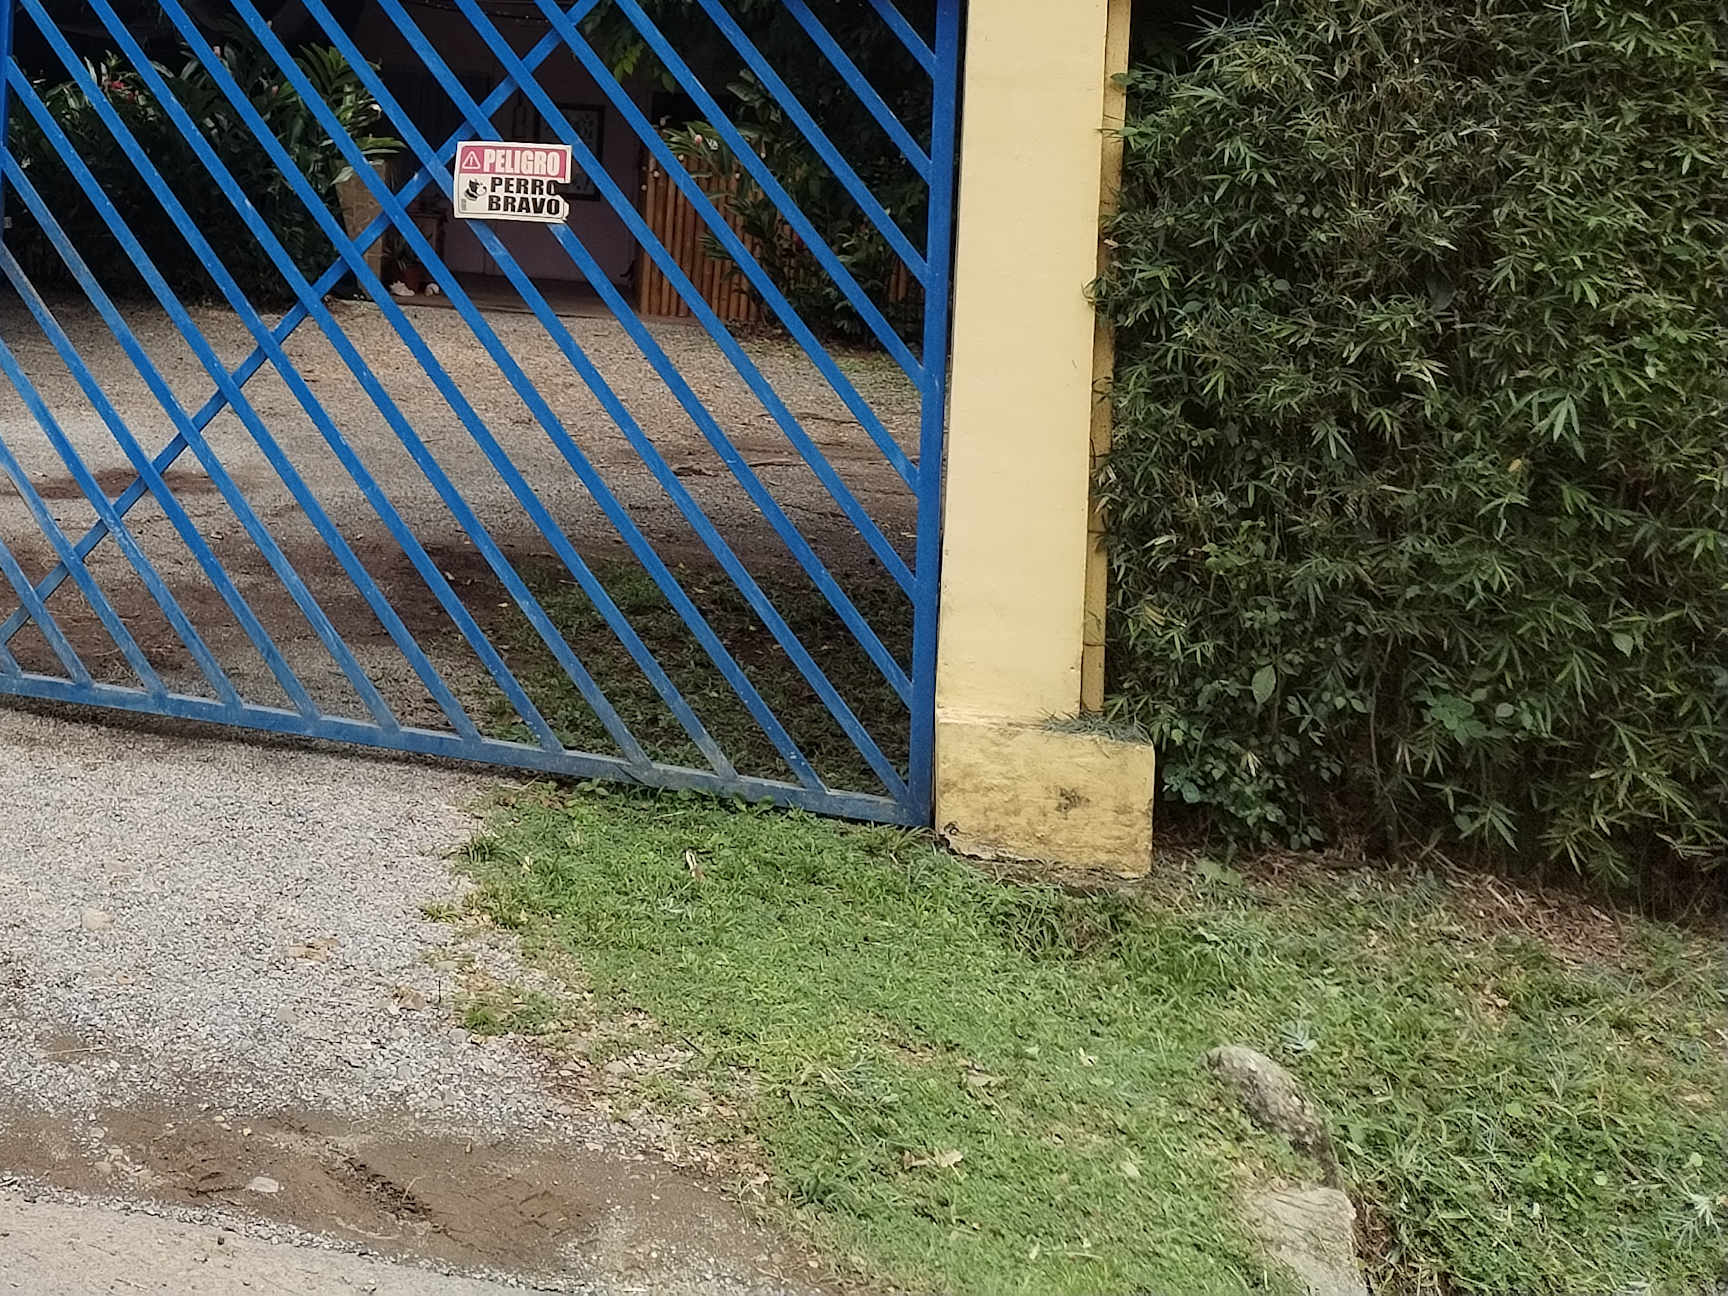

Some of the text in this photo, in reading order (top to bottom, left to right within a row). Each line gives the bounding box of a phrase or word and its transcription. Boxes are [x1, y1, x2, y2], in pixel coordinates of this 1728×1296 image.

[483, 149, 560, 176] PELIGRO
[490, 177, 559, 196] PERRO
[488, 195, 560, 215] BRAVO
